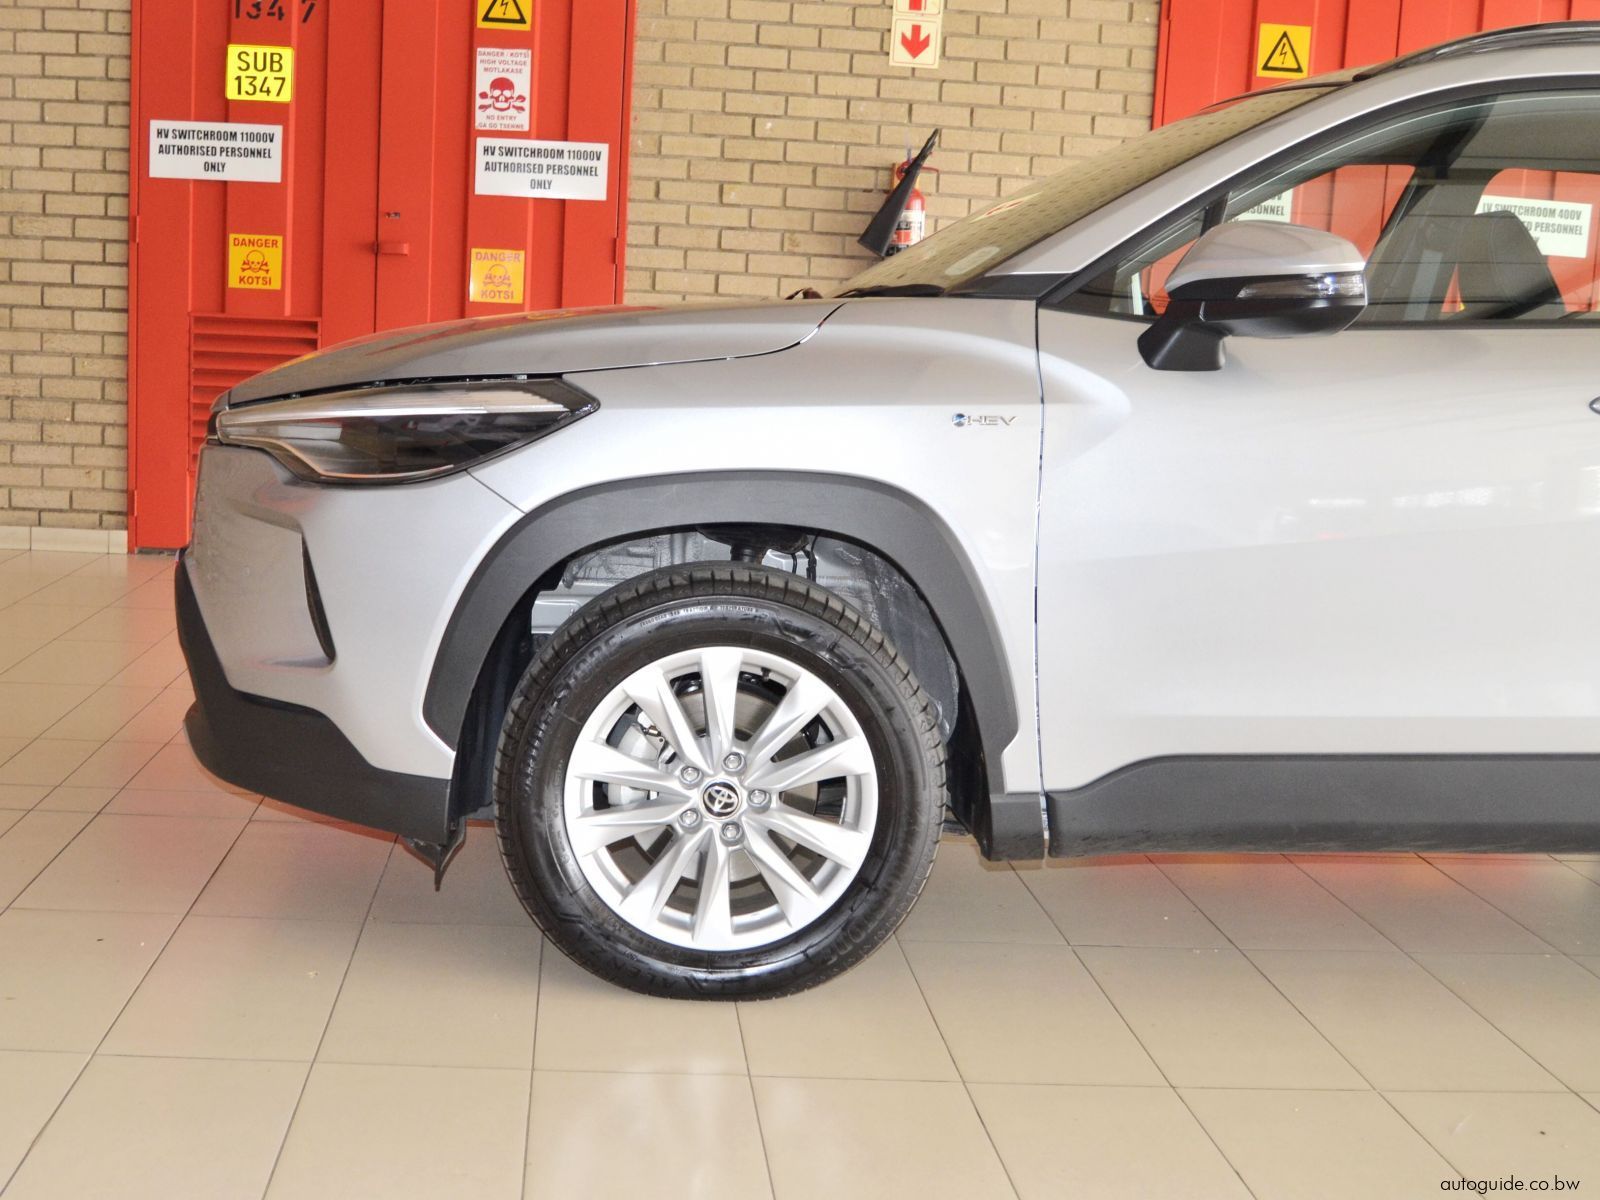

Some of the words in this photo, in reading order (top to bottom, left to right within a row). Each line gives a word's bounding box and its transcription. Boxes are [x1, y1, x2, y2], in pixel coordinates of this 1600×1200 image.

[237, 51, 283, 72] SUB
[234, 75, 286, 97] 1347
[157, 128, 169, 139] HV
[172, 129, 237, 142] SWITCHROOM
[241, 132, 274, 143] 11000V
[158, 144, 217, 156] AUTHORISED
[220, 147, 272, 159] PERSONNEL
[483, 145, 496, 156] HV
[498, 146, 564, 160] SWITCHROOM
[567, 150, 602, 161] 11000V
[203, 162, 226, 172] ONLY
[484, 161, 544, 174] AUTHORISED
[546, 164, 599, 177] PERSONNEL
[530, 179, 552, 190] ONLY
[1557, 209, 1582, 220] 400V
[1534, 221, 1583, 235] PERSONNEL
[233, 238, 278, 248] DANGER
[475, 252, 521, 262] DANGER
[238, 275, 272, 286] KOTSI
[481, 290, 514, 300] KOTSI
[967, 415, 1017, 426] HEV
